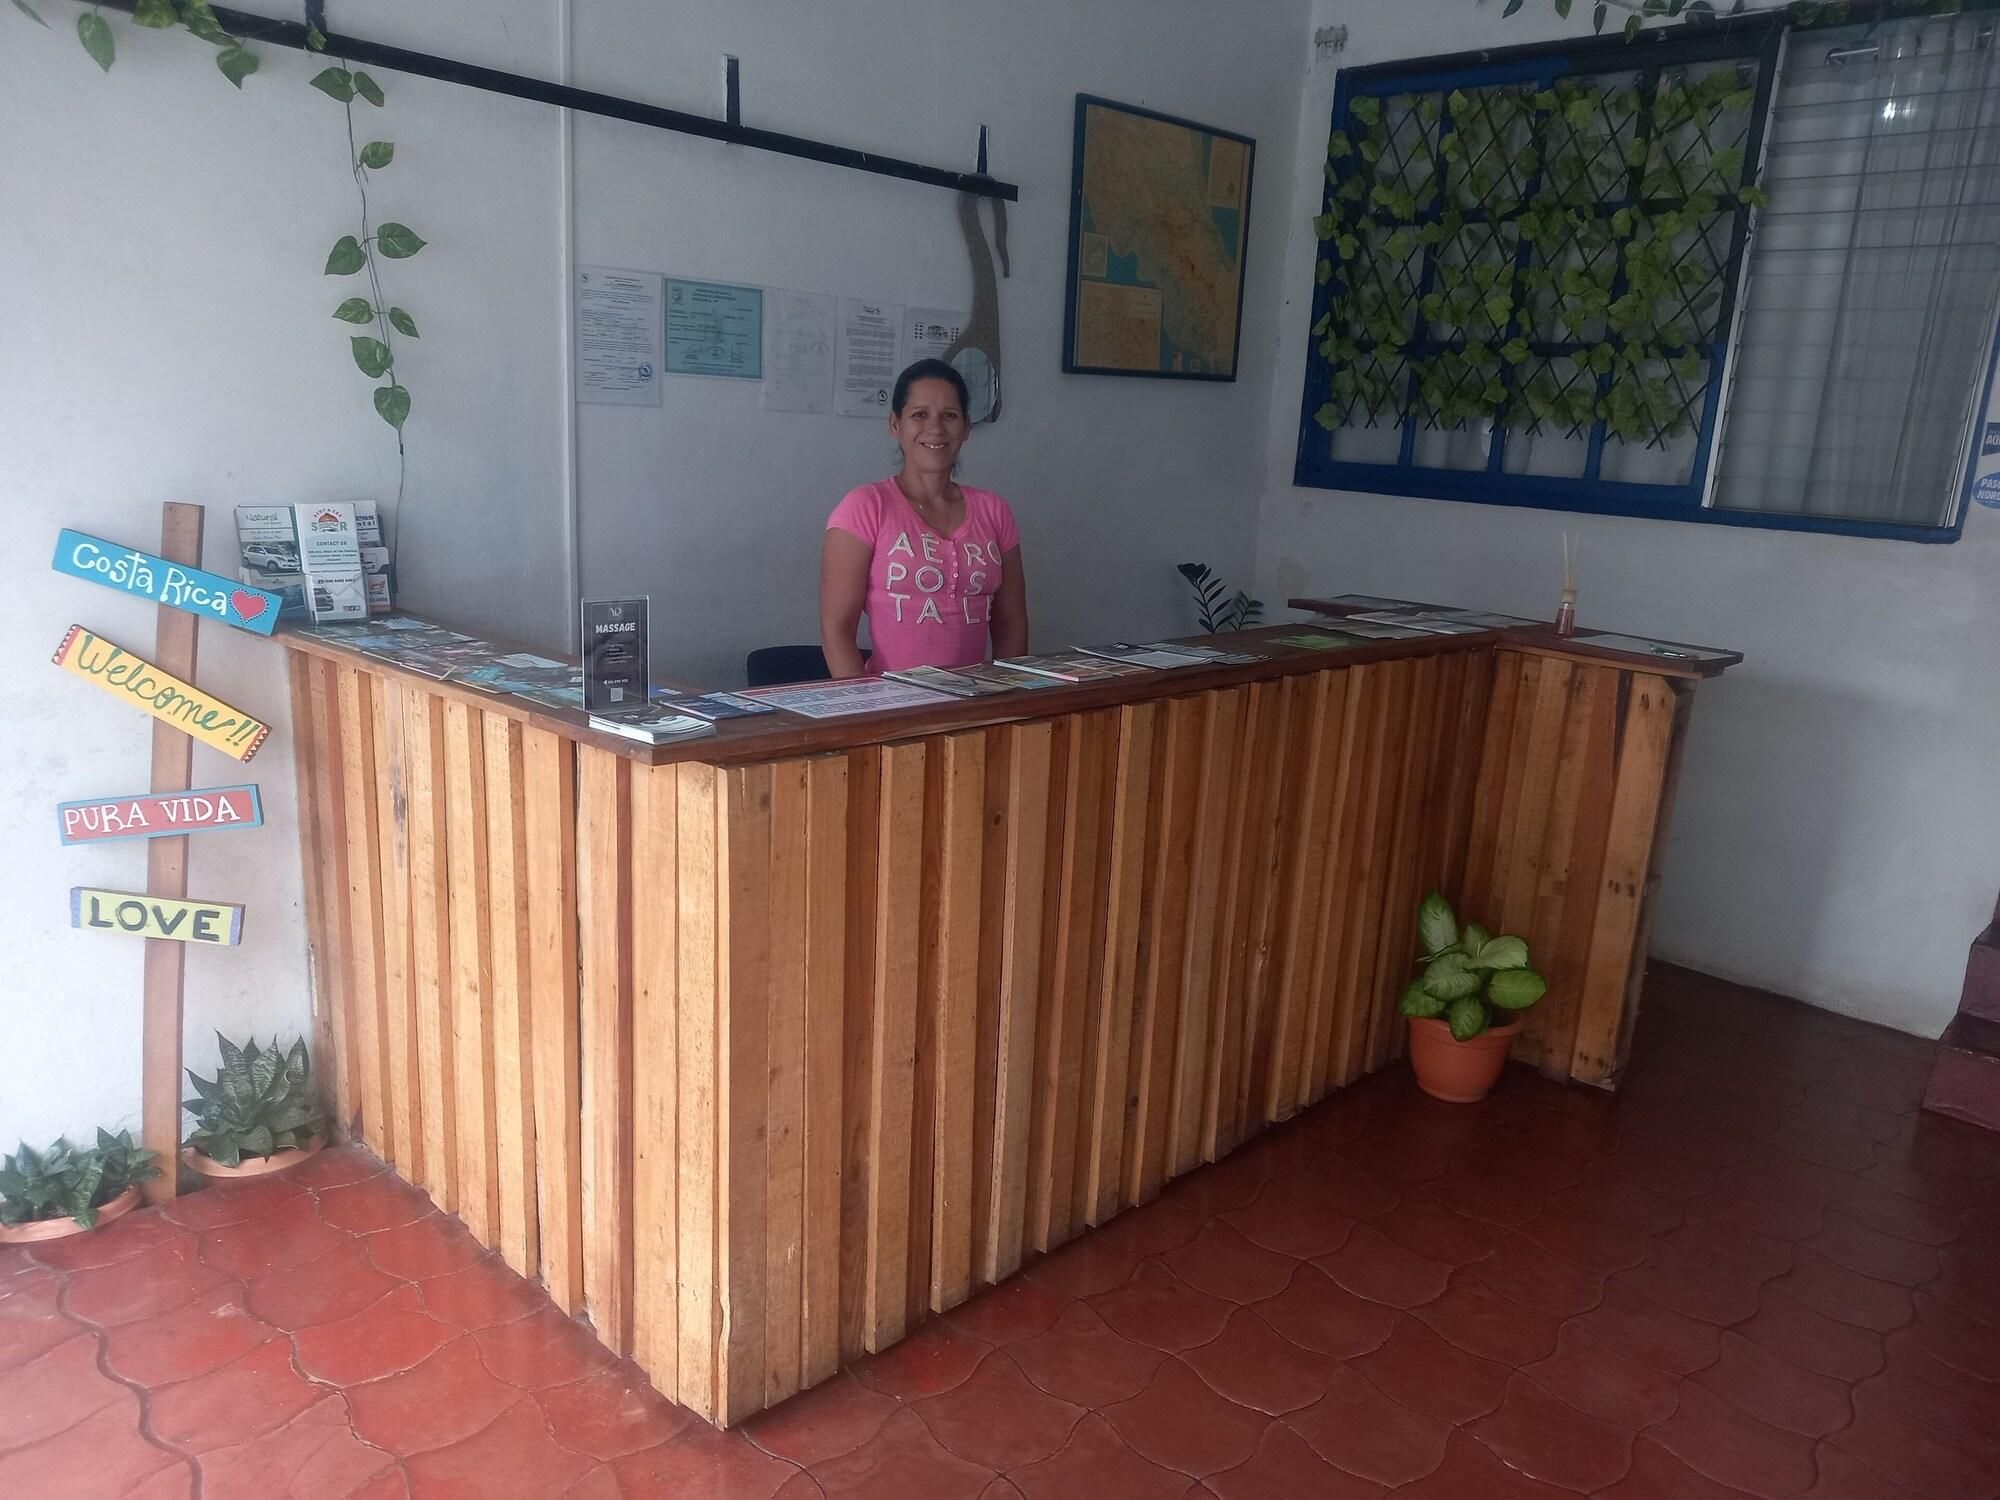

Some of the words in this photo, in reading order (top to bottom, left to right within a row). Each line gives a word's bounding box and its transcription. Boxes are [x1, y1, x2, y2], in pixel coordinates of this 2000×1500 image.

[72, 543, 154, 595] Costa
[159, 567, 228, 616] Rica
[595, 622, 637, 634] MASSAGE
[77, 634, 261, 747] Welcome!!
[63, 801, 150, 836] PURA
[158, 795, 241, 824] VIDA
[88, 895, 221, 942] LOVE
